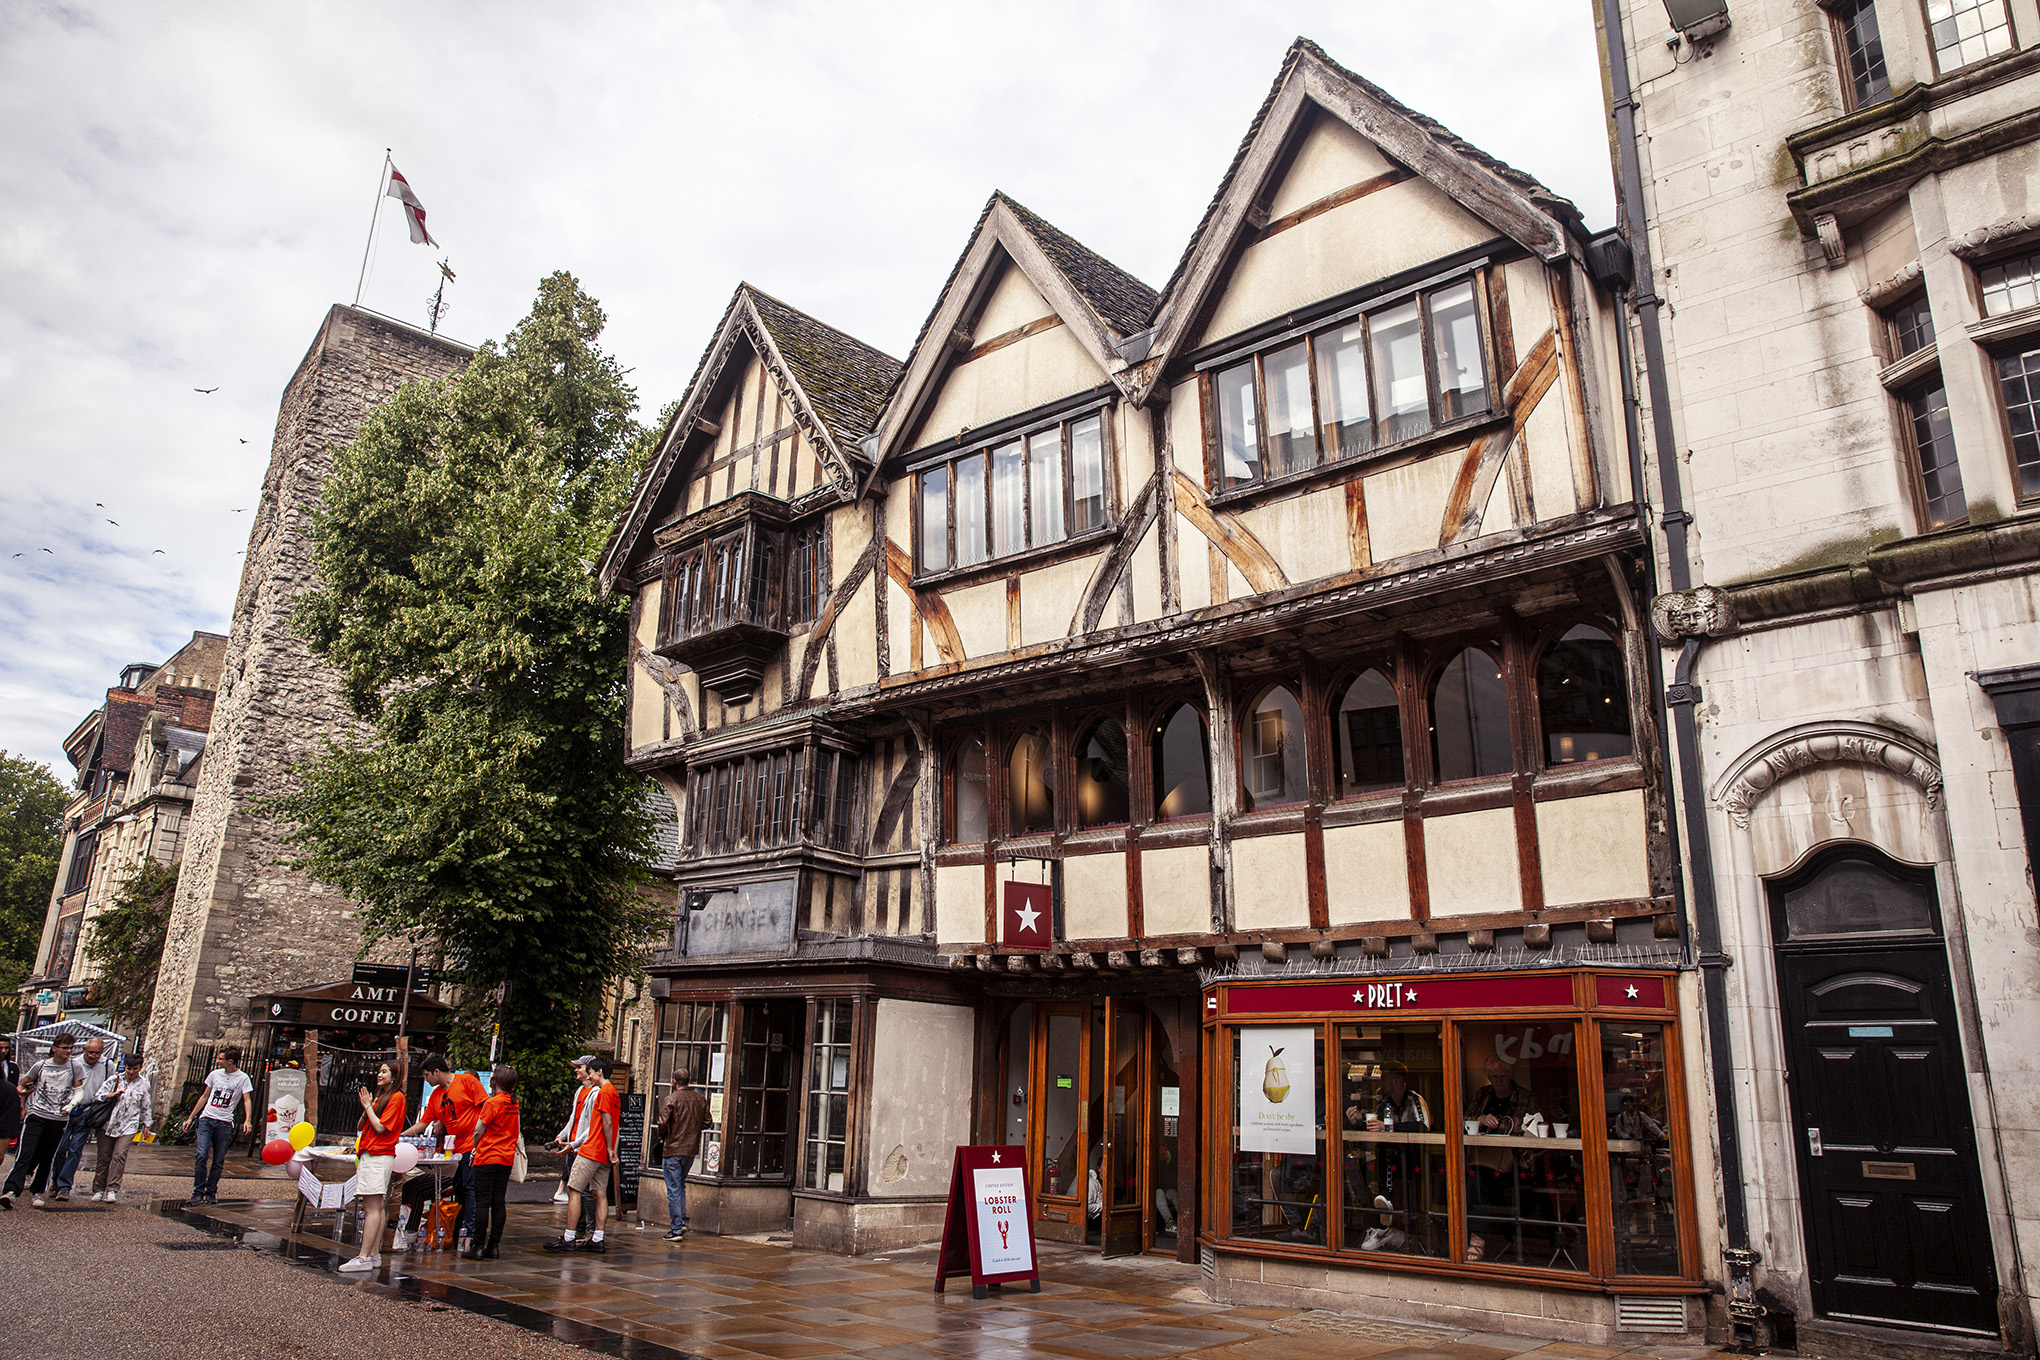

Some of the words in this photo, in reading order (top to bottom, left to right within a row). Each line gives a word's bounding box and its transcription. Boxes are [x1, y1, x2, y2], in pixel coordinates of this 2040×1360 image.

[351, 986, 398, 1002] AMT
[1368, 983, 1403, 1008] PRET
[1258, 1112, 1275, 1120] Don't
[1276, 1112, 1284, 1120] be
[1285, 1112, 1295, 1122] shy
[984, 1195, 1017, 1205] LOBSTER
[992, 1205, 1011, 1214] ROLL
